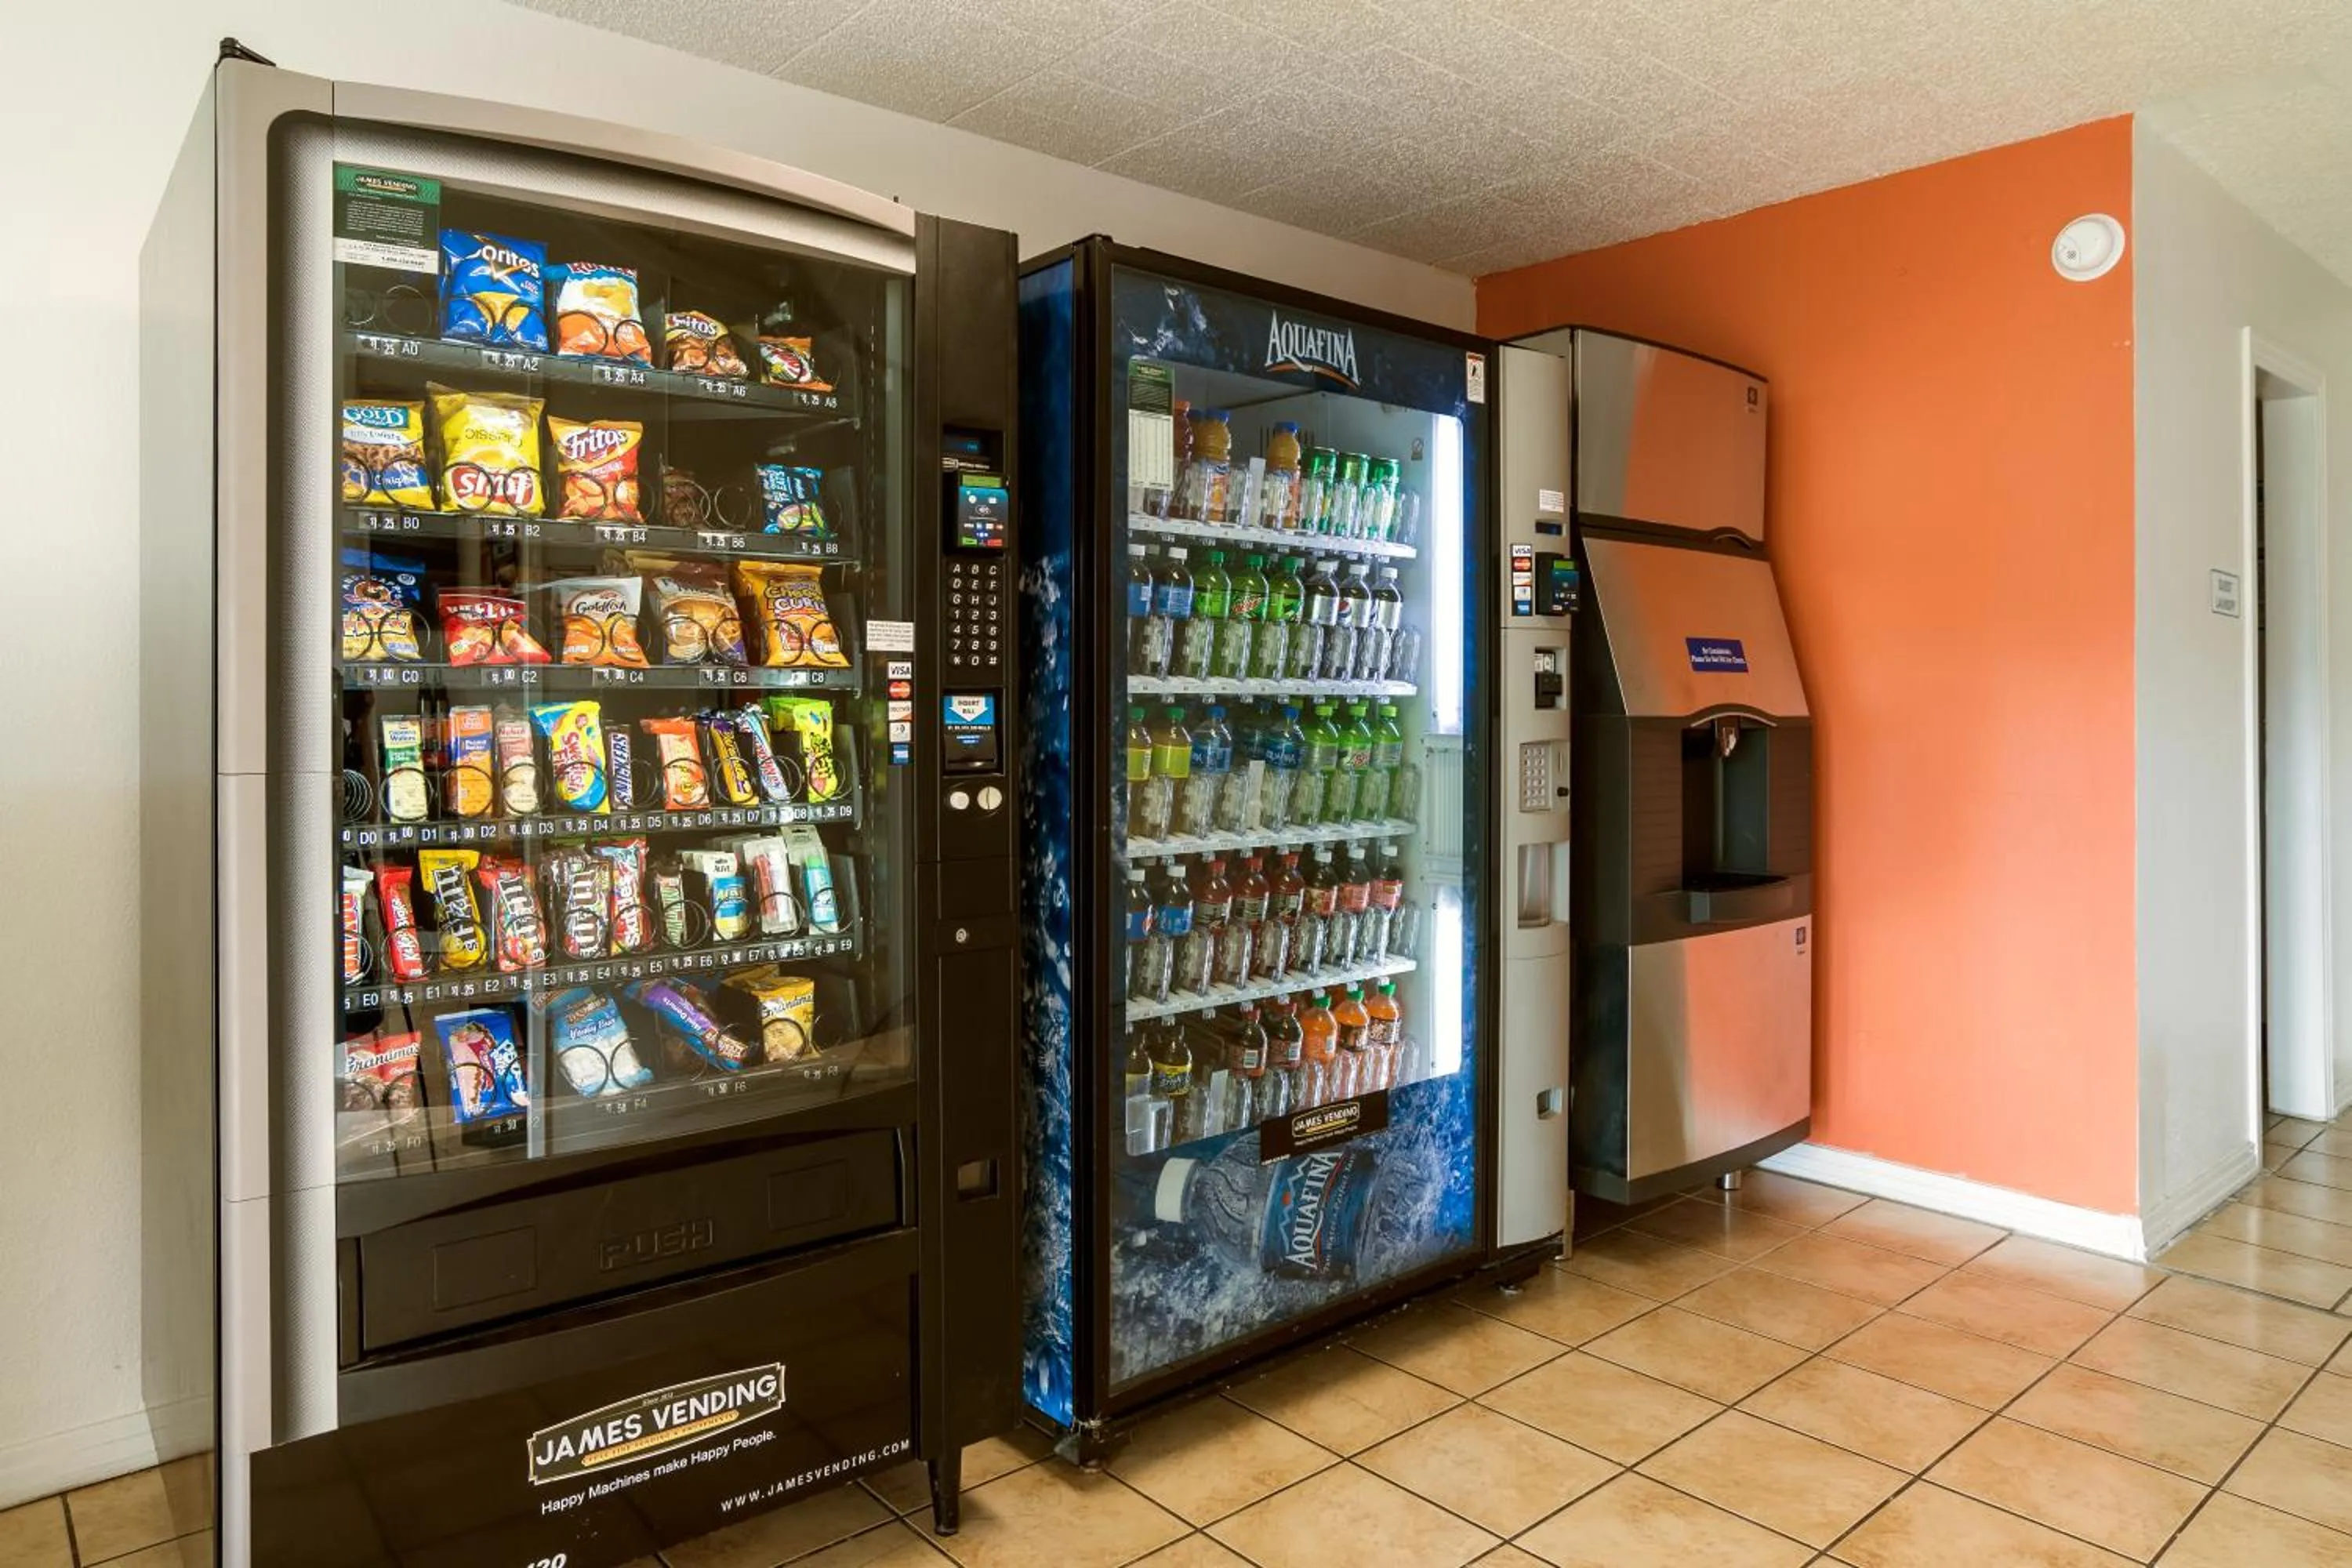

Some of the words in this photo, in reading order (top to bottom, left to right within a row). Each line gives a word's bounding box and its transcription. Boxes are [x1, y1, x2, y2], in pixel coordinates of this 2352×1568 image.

[1265, 309, 1360, 386] AQUAFINA
[523, 358, 539, 372] A2
[630, 371, 645, 385] A4
[565, 426, 626, 459] Fritos
[404, 517, 419, 529] B0
[524, 524, 540, 536] B2
[633, 531, 647, 543] B4
[953, 564, 960, 573] A
[971, 564, 979, 574] B
[989, 565, 996, 575] C
[971, 579, 979, 590] E
[989, 580, 996, 590] F
[953, 593, 961, 604] G
[971, 595, 979, 604] H
[989, 595, 996, 606] J
[575, 598, 627, 615] Goldfish
[954, 610, 960, 619] 1
[971, 610, 979, 620] 2
[989, 611, 996, 620] 3
[953, 625, 960, 633] 4
[971, 625, 979, 634] 5
[989, 626, 996, 636] 6
[953, 640, 960, 650] 7
[971, 640, 979, 650] 8
[989, 641, 996, 651] 9
[402, 670, 419, 684] C0
[521, 670, 538, 684] C2
[630, 670, 644, 683] C4
[890, 666, 910, 675] VISA
[611, 732, 633, 805] SNICKERS
[747, 809, 760, 822] D7
[840, 805, 852, 816] D9
[593, 819, 608, 831] D4
[647, 816, 662, 828] D5
[698, 813, 712, 826] D6
[481, 825, 496, 838] D2
[539, 822, 554, 833] D3
[360, 831, 377, 844] D0
[421, 828, 437, 841] D1
[700, 956, 713, 967] E6
[748, 949, 760, 961] E7
[597, 967, 611, 979] E4
[650, 960, 662, 973] E5
[543, 973, 557, 985] E3
[426, 985, 440, 1000] E1
[485, 980, 499, 992] E2
[363, 993, 379, 1007] E0
[1285, 1151, 1343, 1271] AQUAFINA
[535, 1414, 642, 1466] JAMES
[652, 1374, 777, 1430] VENDING
[541, 1490, 585, 1515] Happy
[588, 1469, 651, 1499] Machines
[652, 1458, 688, 1482] make
[690, 1444, 730, 1468] Happy
[732, 1429, 777, 1453] People.
[720, 1439, 910, 1513] WWW.JAMESVENDING.COM
